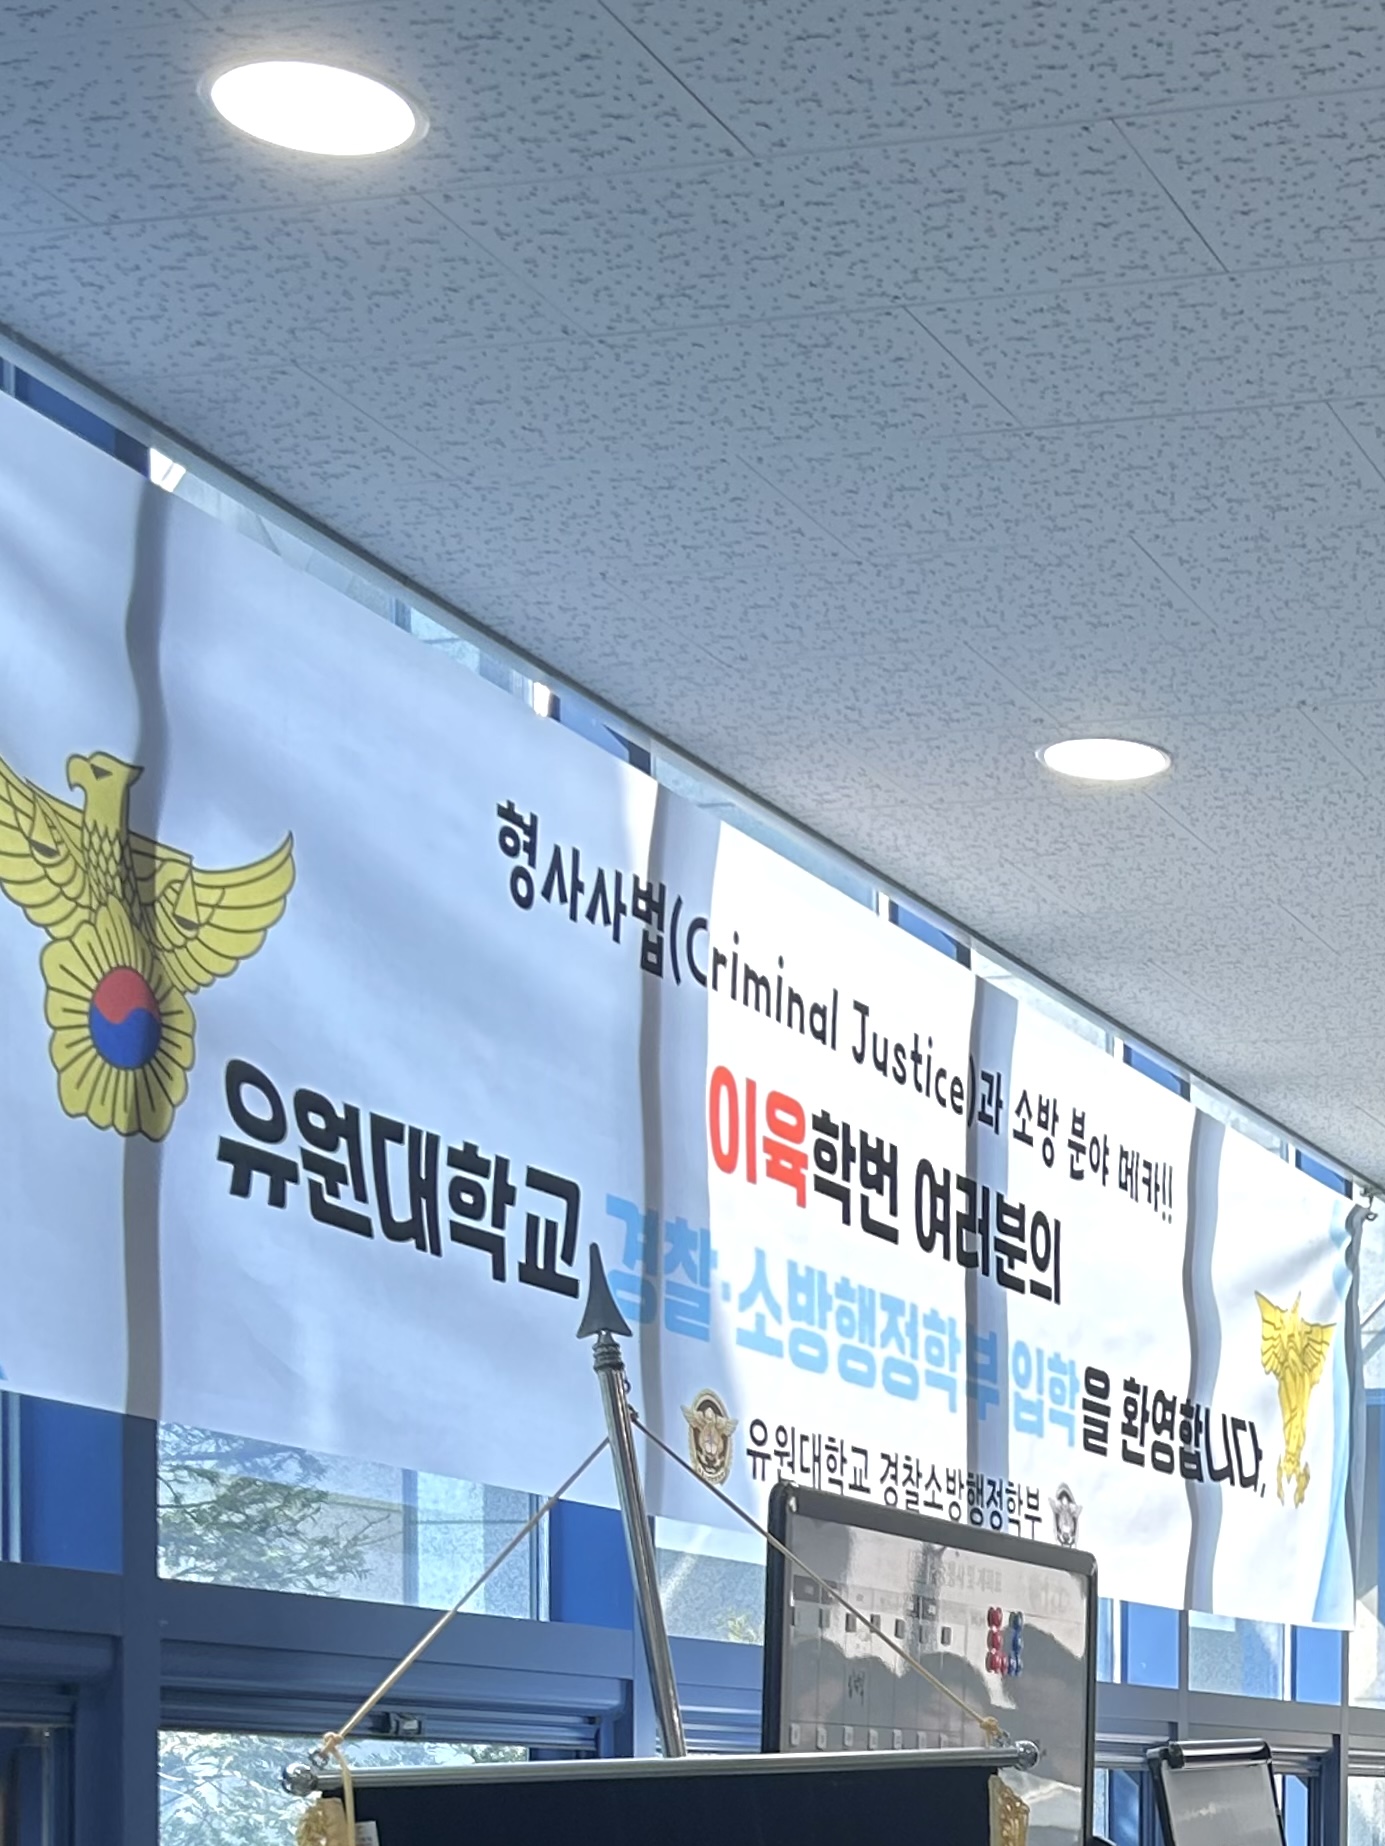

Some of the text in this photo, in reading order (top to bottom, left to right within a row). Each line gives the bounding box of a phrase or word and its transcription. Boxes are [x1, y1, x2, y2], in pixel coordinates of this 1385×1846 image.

[496, 799, 1174, 1225] 형사사법(Criminal Justice)과 소방 분야 메카!!
[216, 1058, 581, 1299] 유원대학교
[708, 1065, 1061, 1304] 이육학번 여러분의
[746, 1418, 1043, 1541] 유원대학교 경찰소방행정학부
